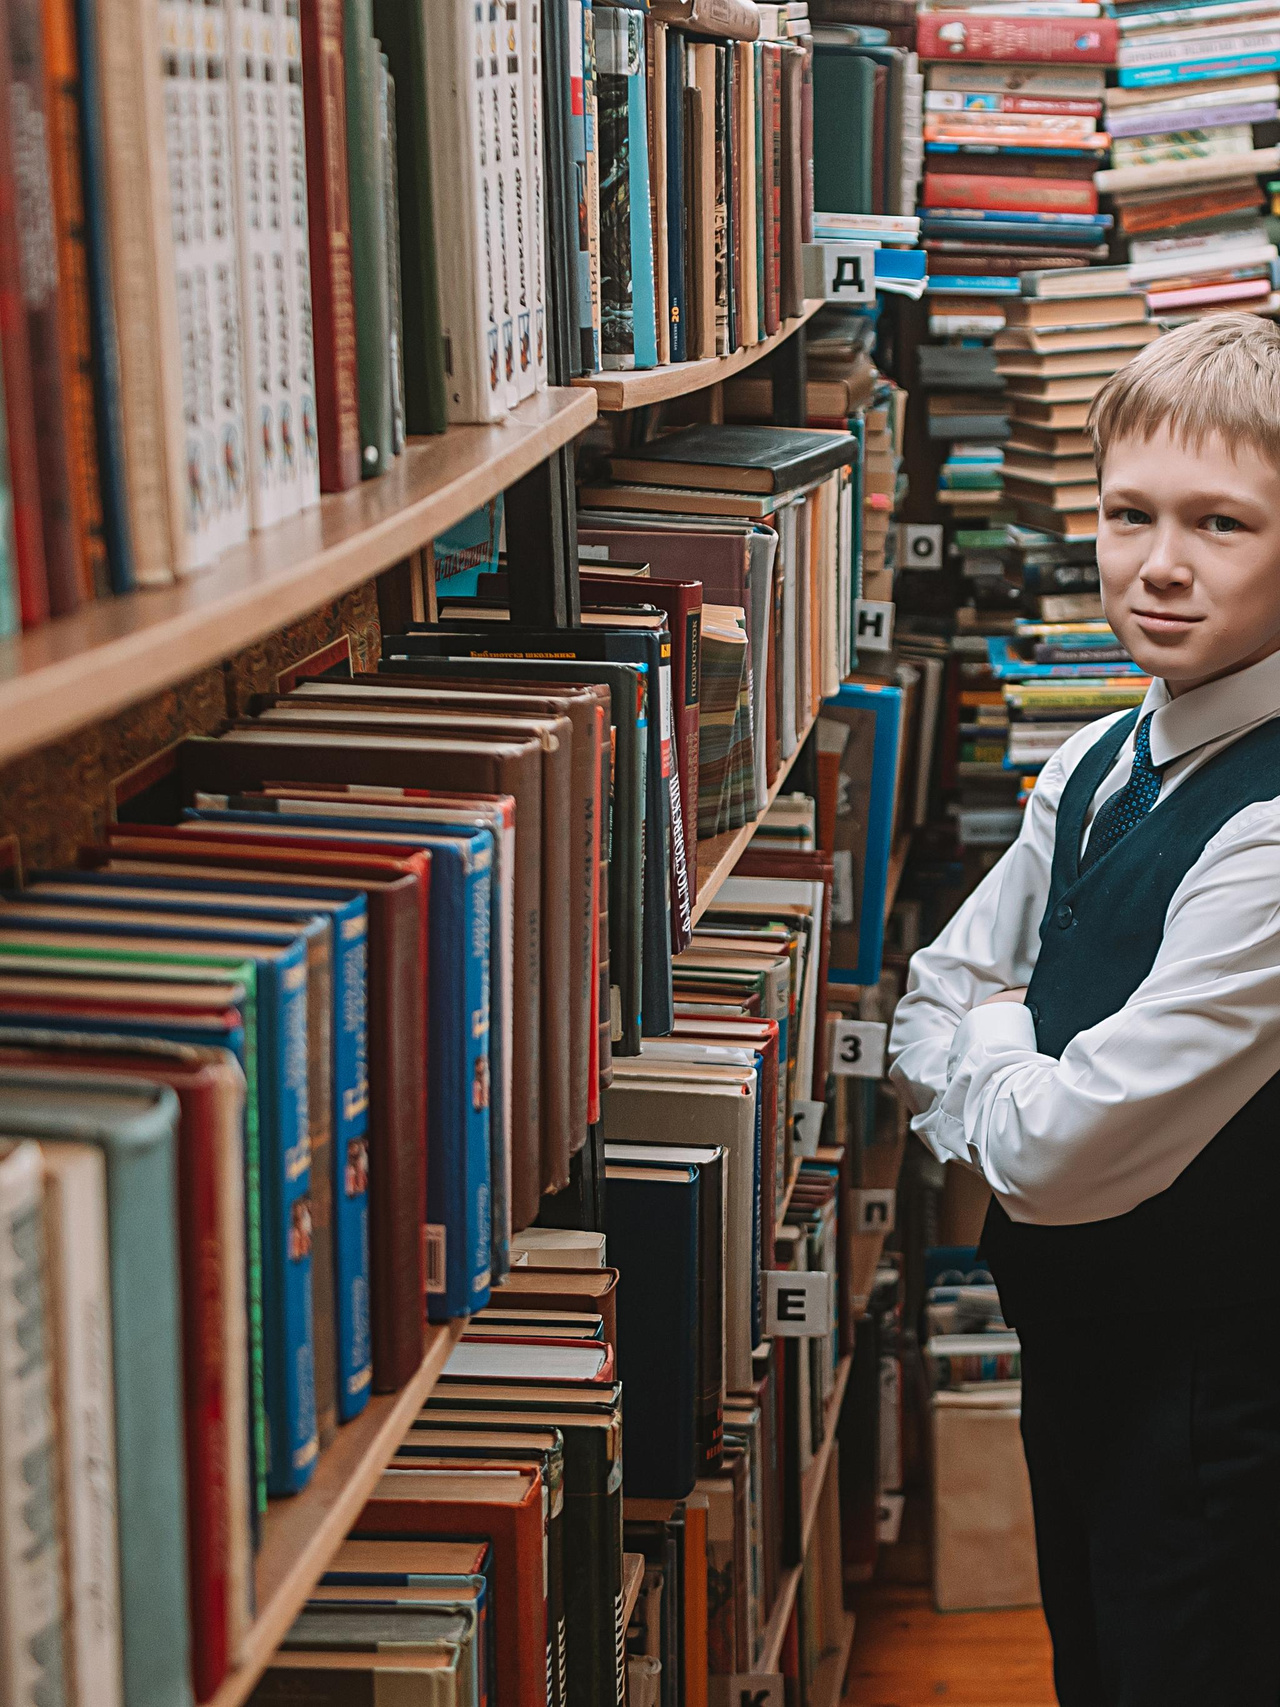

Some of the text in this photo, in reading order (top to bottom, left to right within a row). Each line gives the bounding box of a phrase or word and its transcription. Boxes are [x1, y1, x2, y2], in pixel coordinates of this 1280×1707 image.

[508, 82, 527, 308] Александр БЛОК
[832, 256, 865, 292] Д
[671, 306, 680, 323] 20
[913, 537, 932, 557] О
[858, 610, 884, 637] Н
[690, 619, 699, 697] ПОДРОСТОК
[865, 1202, 887, 1222] П
[778, 1288, 806, 1322] Е
